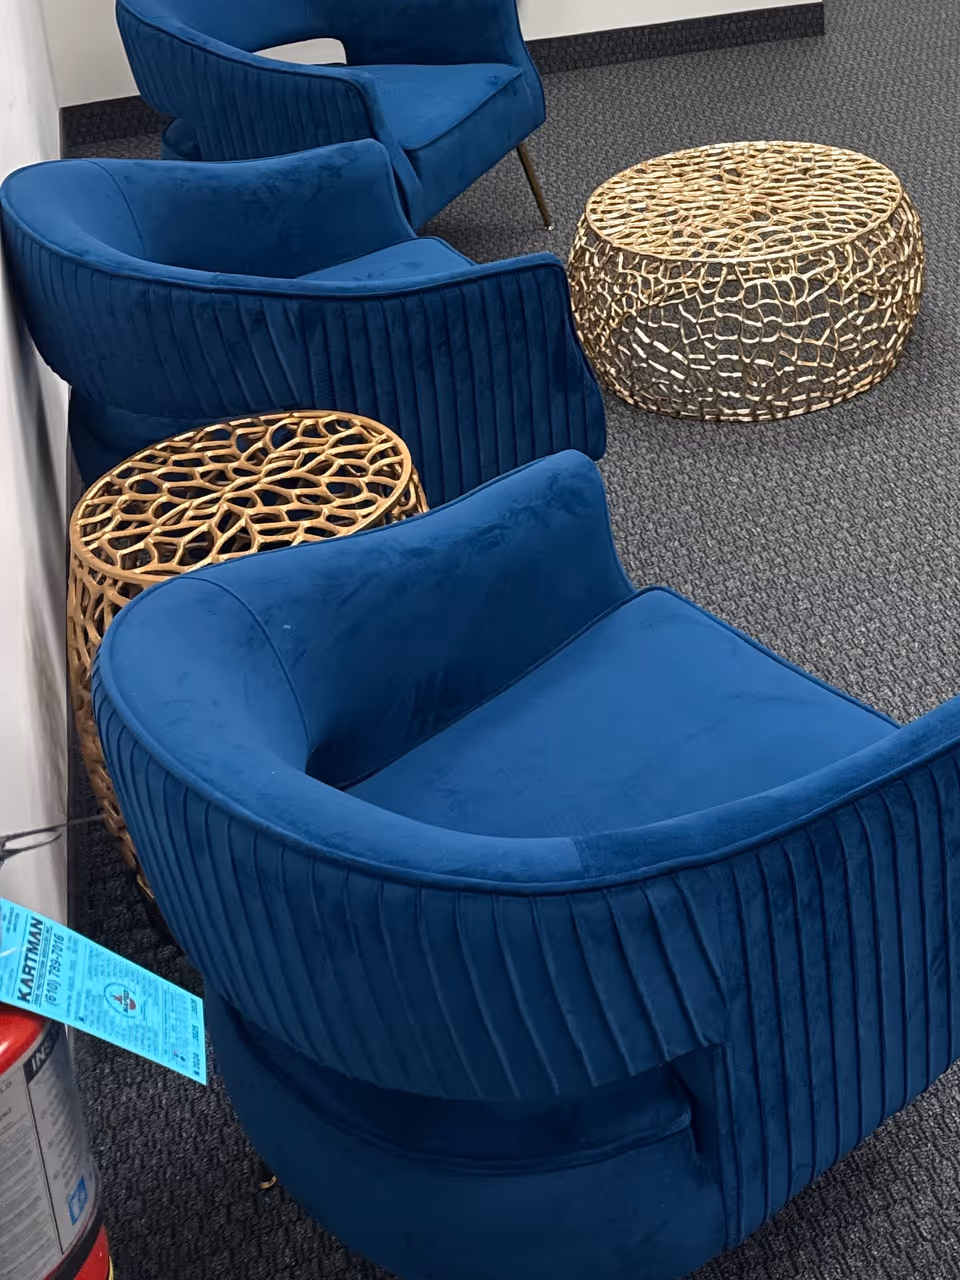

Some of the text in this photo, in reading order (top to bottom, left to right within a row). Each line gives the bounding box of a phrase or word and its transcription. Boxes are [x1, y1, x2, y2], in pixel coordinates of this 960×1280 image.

[17, 916, 43, 1004] KARTMAN
[45, 933, 65, 1006] (610) 789-7016
